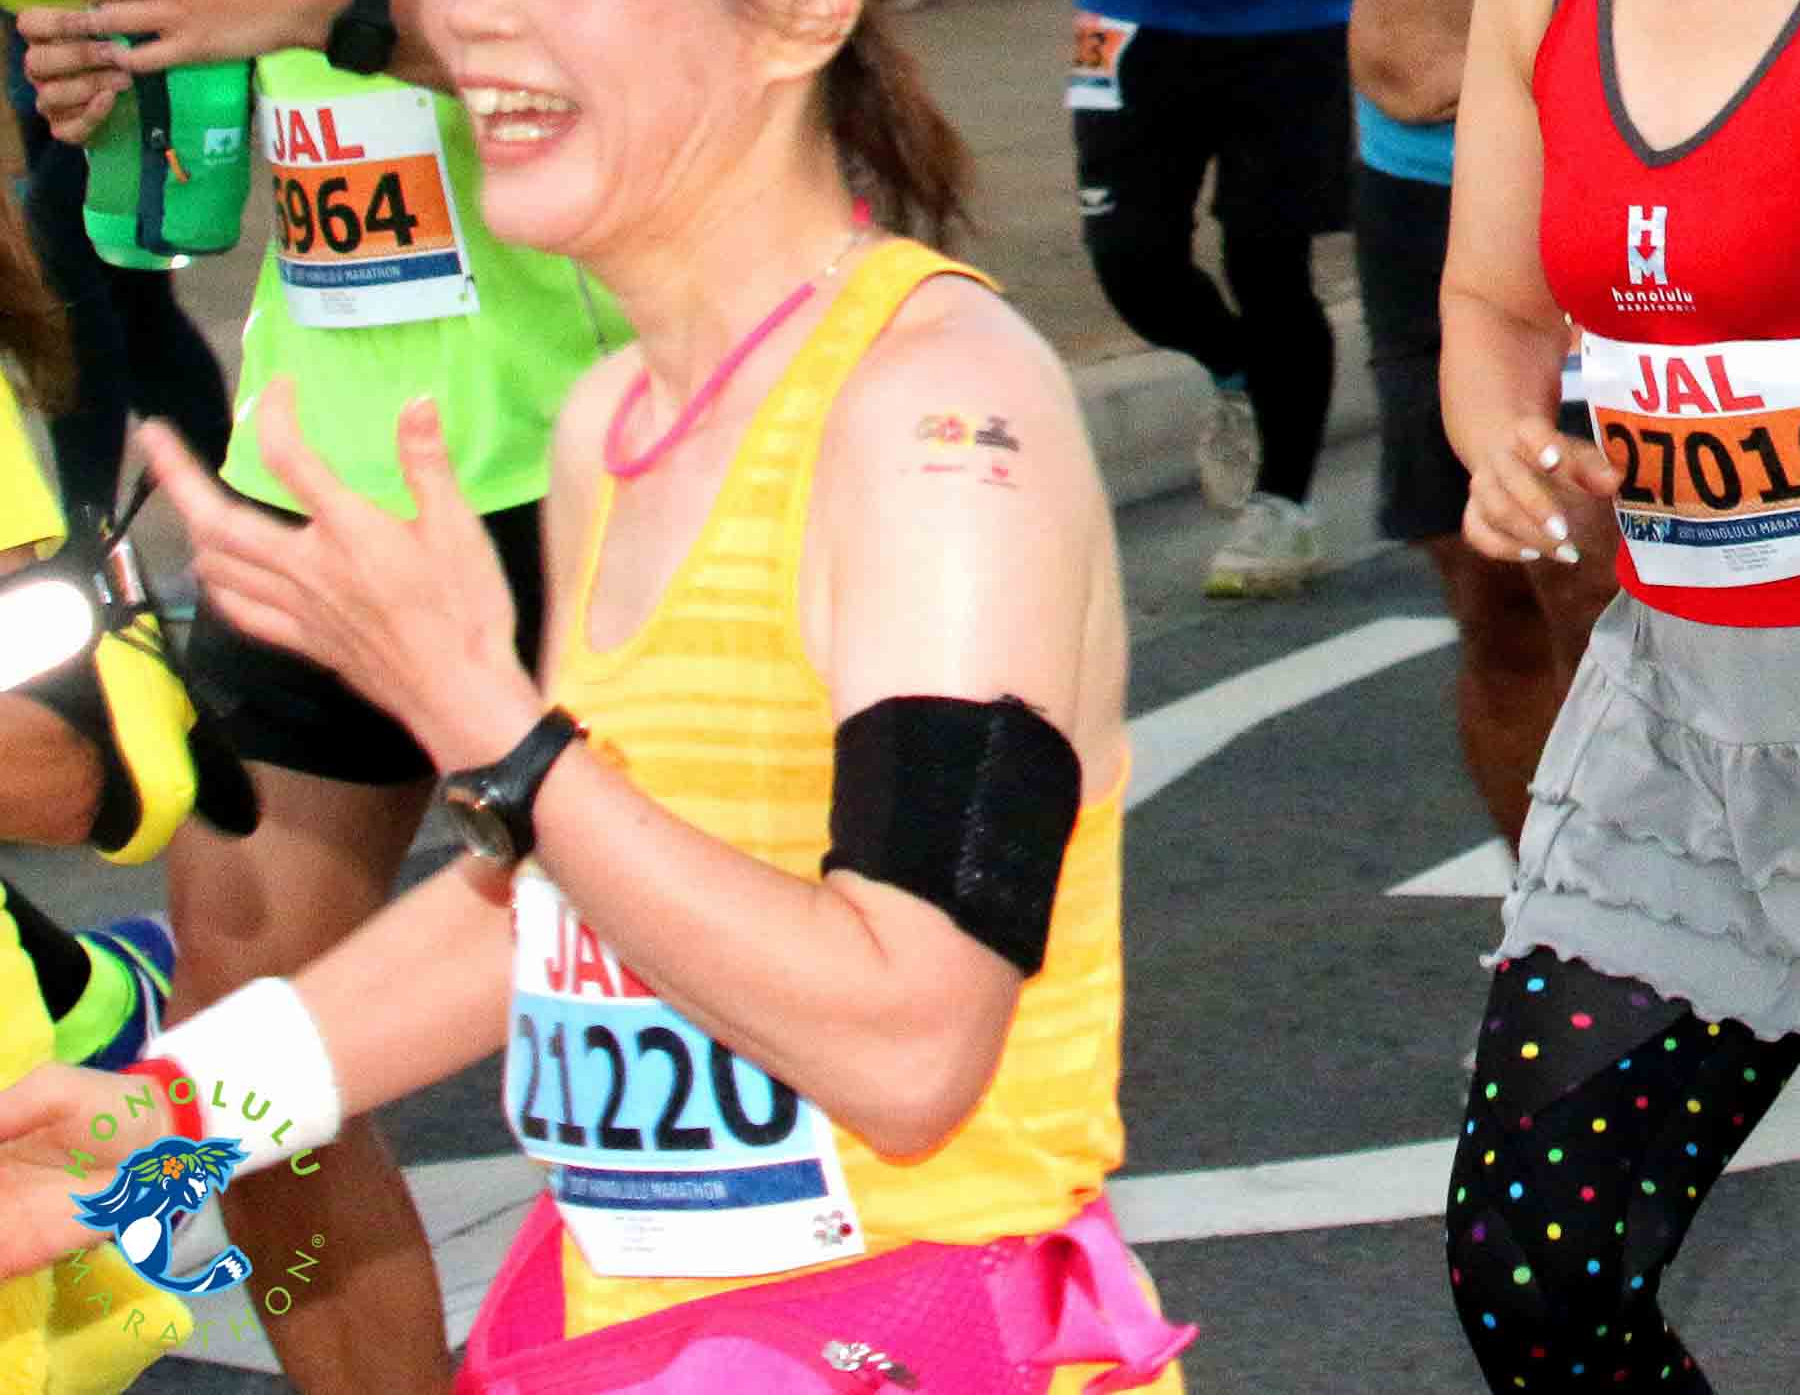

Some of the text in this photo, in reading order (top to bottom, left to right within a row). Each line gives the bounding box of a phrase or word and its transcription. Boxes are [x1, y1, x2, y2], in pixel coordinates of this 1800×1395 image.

[273, 108, 365, 162] JAL
[1611, 286, 1693, 302] honolulu
[1631, 354, 1766, 414] JAL
[1697, 523, 1756, 542] HONOLULU
